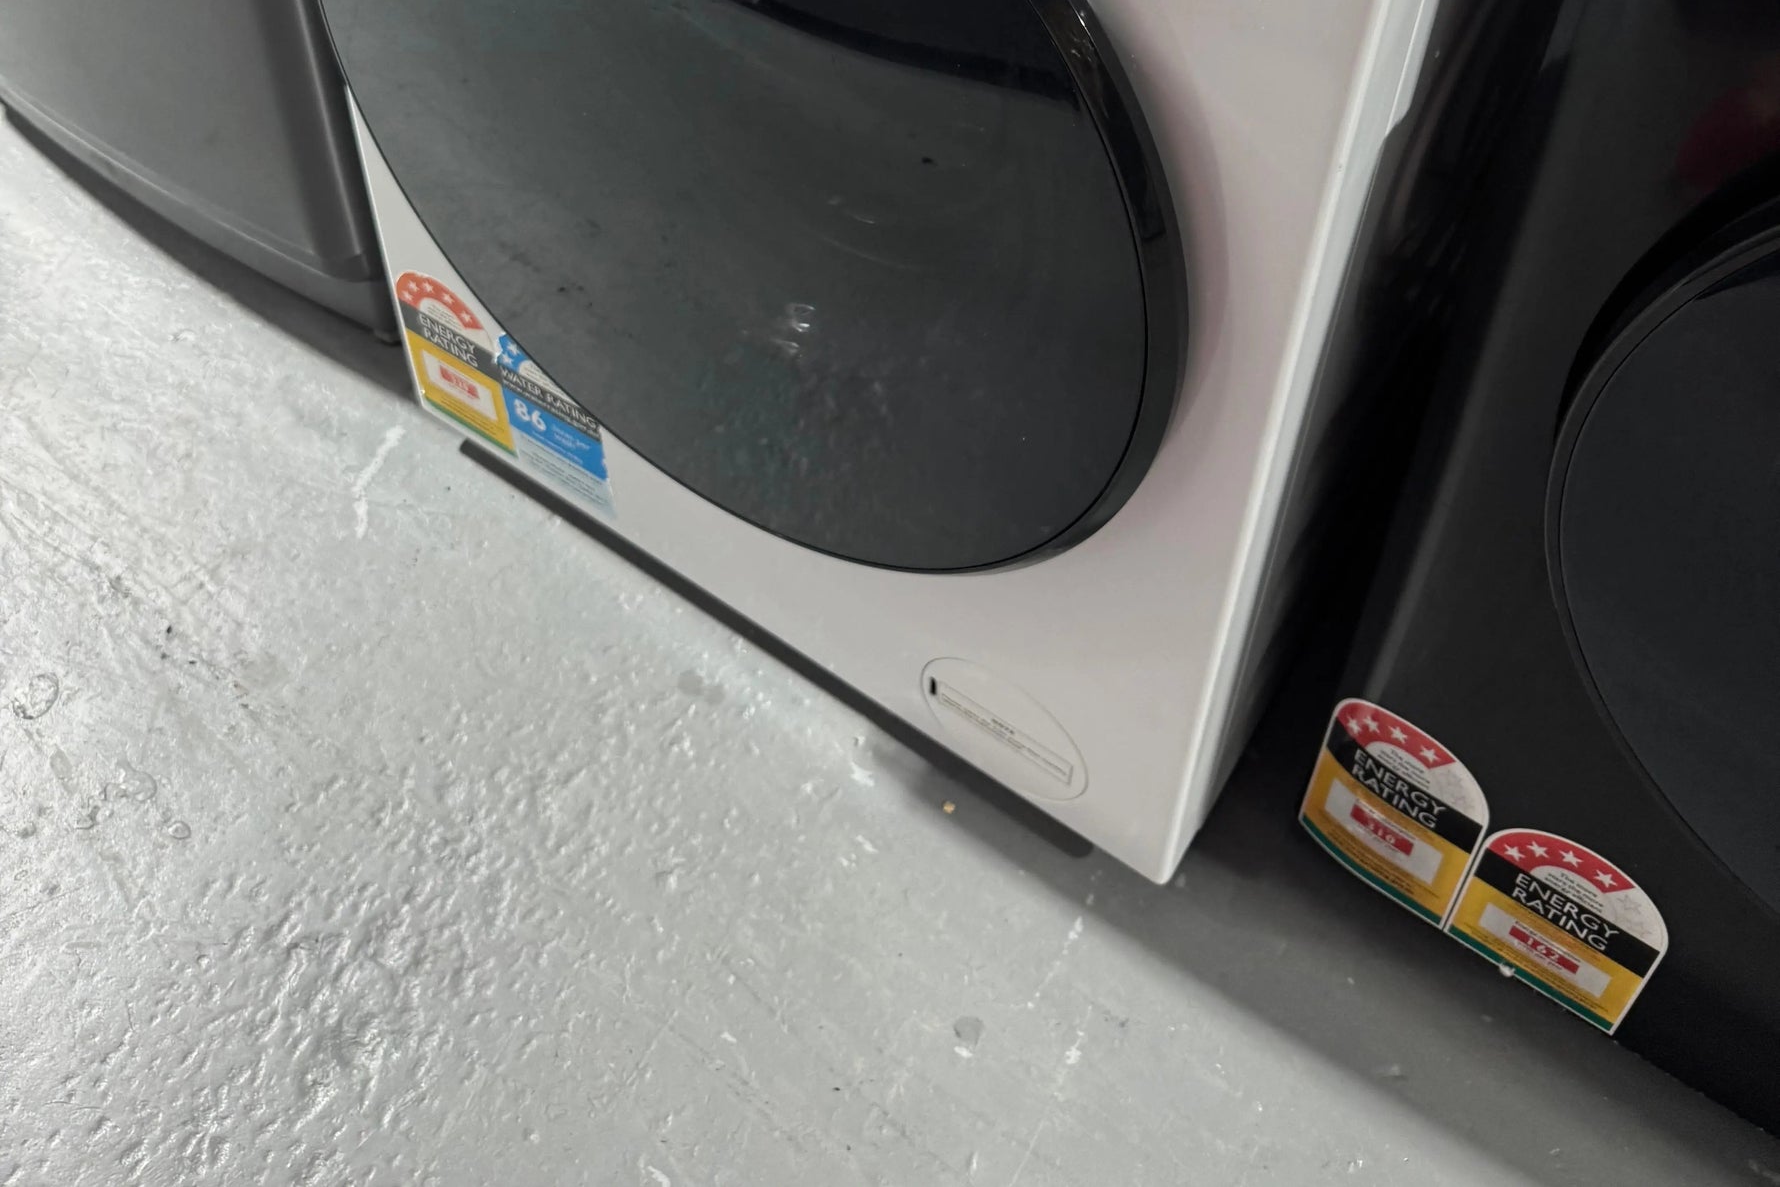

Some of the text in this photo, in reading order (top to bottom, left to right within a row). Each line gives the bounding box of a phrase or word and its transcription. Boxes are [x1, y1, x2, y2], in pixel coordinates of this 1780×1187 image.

[419, 313, 475, 354] ENERGY
[424, 327, 478, 368] RATING
[501, 367, 544, 398] WATER
[547, 393, 597, 428] RATING
[514, 399, 547, 431] 86
[1351, 763, 1438, 829] RATING
[1353, 748, 1446, 814] ENERGY
[1512, 887, 1608, 951] RATING
[1516, 873, 1620, 938] ENERGY
[1527, 937, 1560, 963] 162
